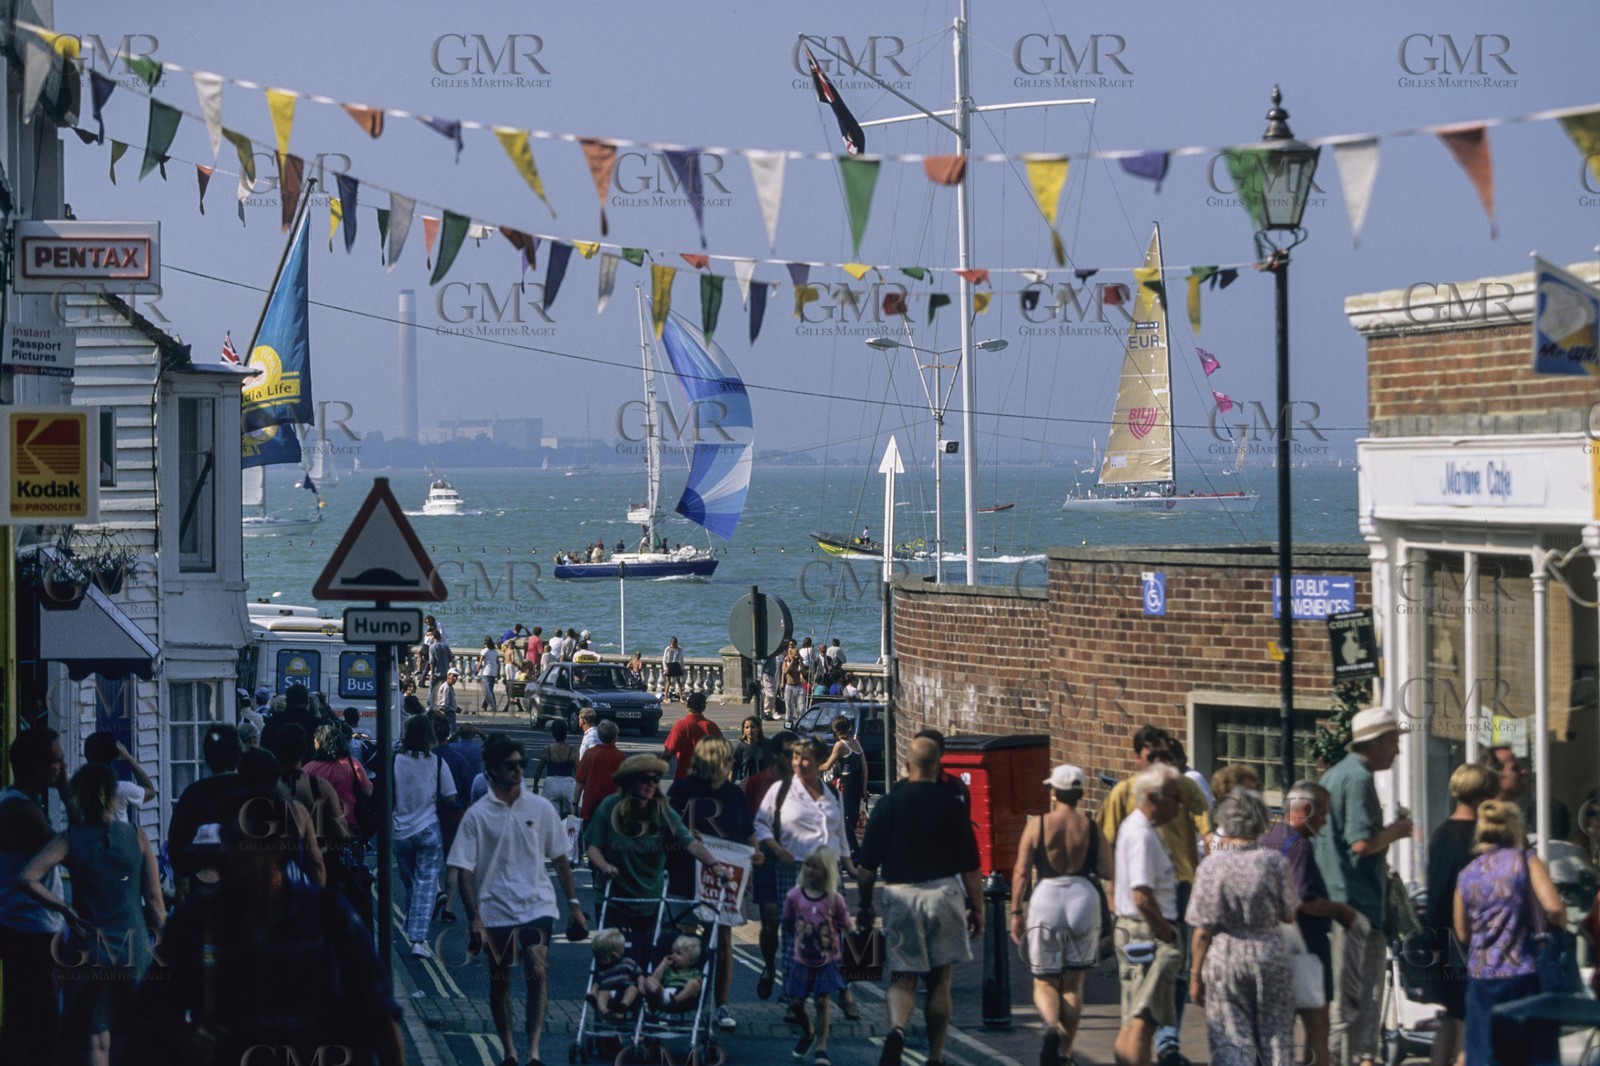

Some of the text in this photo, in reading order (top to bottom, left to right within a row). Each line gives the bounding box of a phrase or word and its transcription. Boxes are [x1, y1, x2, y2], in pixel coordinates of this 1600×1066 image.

[35, 246, 139, 268] PENTAX
[12, 326, 50, 338] Instant
[12, 338, 61, 351] Passport
[1128, 334, 1160, 348] EUR
[12, 350, 57, 362] Pictures
[267, 383, 292, 396] Life
[17, 481, 82, 498] Kodak
[26, 502, 82, 513] PRODUCTS
[1295, 579, 1330, 597] PUBLIC
[354, 617, 412, 638] Hump
[347, 678, 374, 691] Bus
